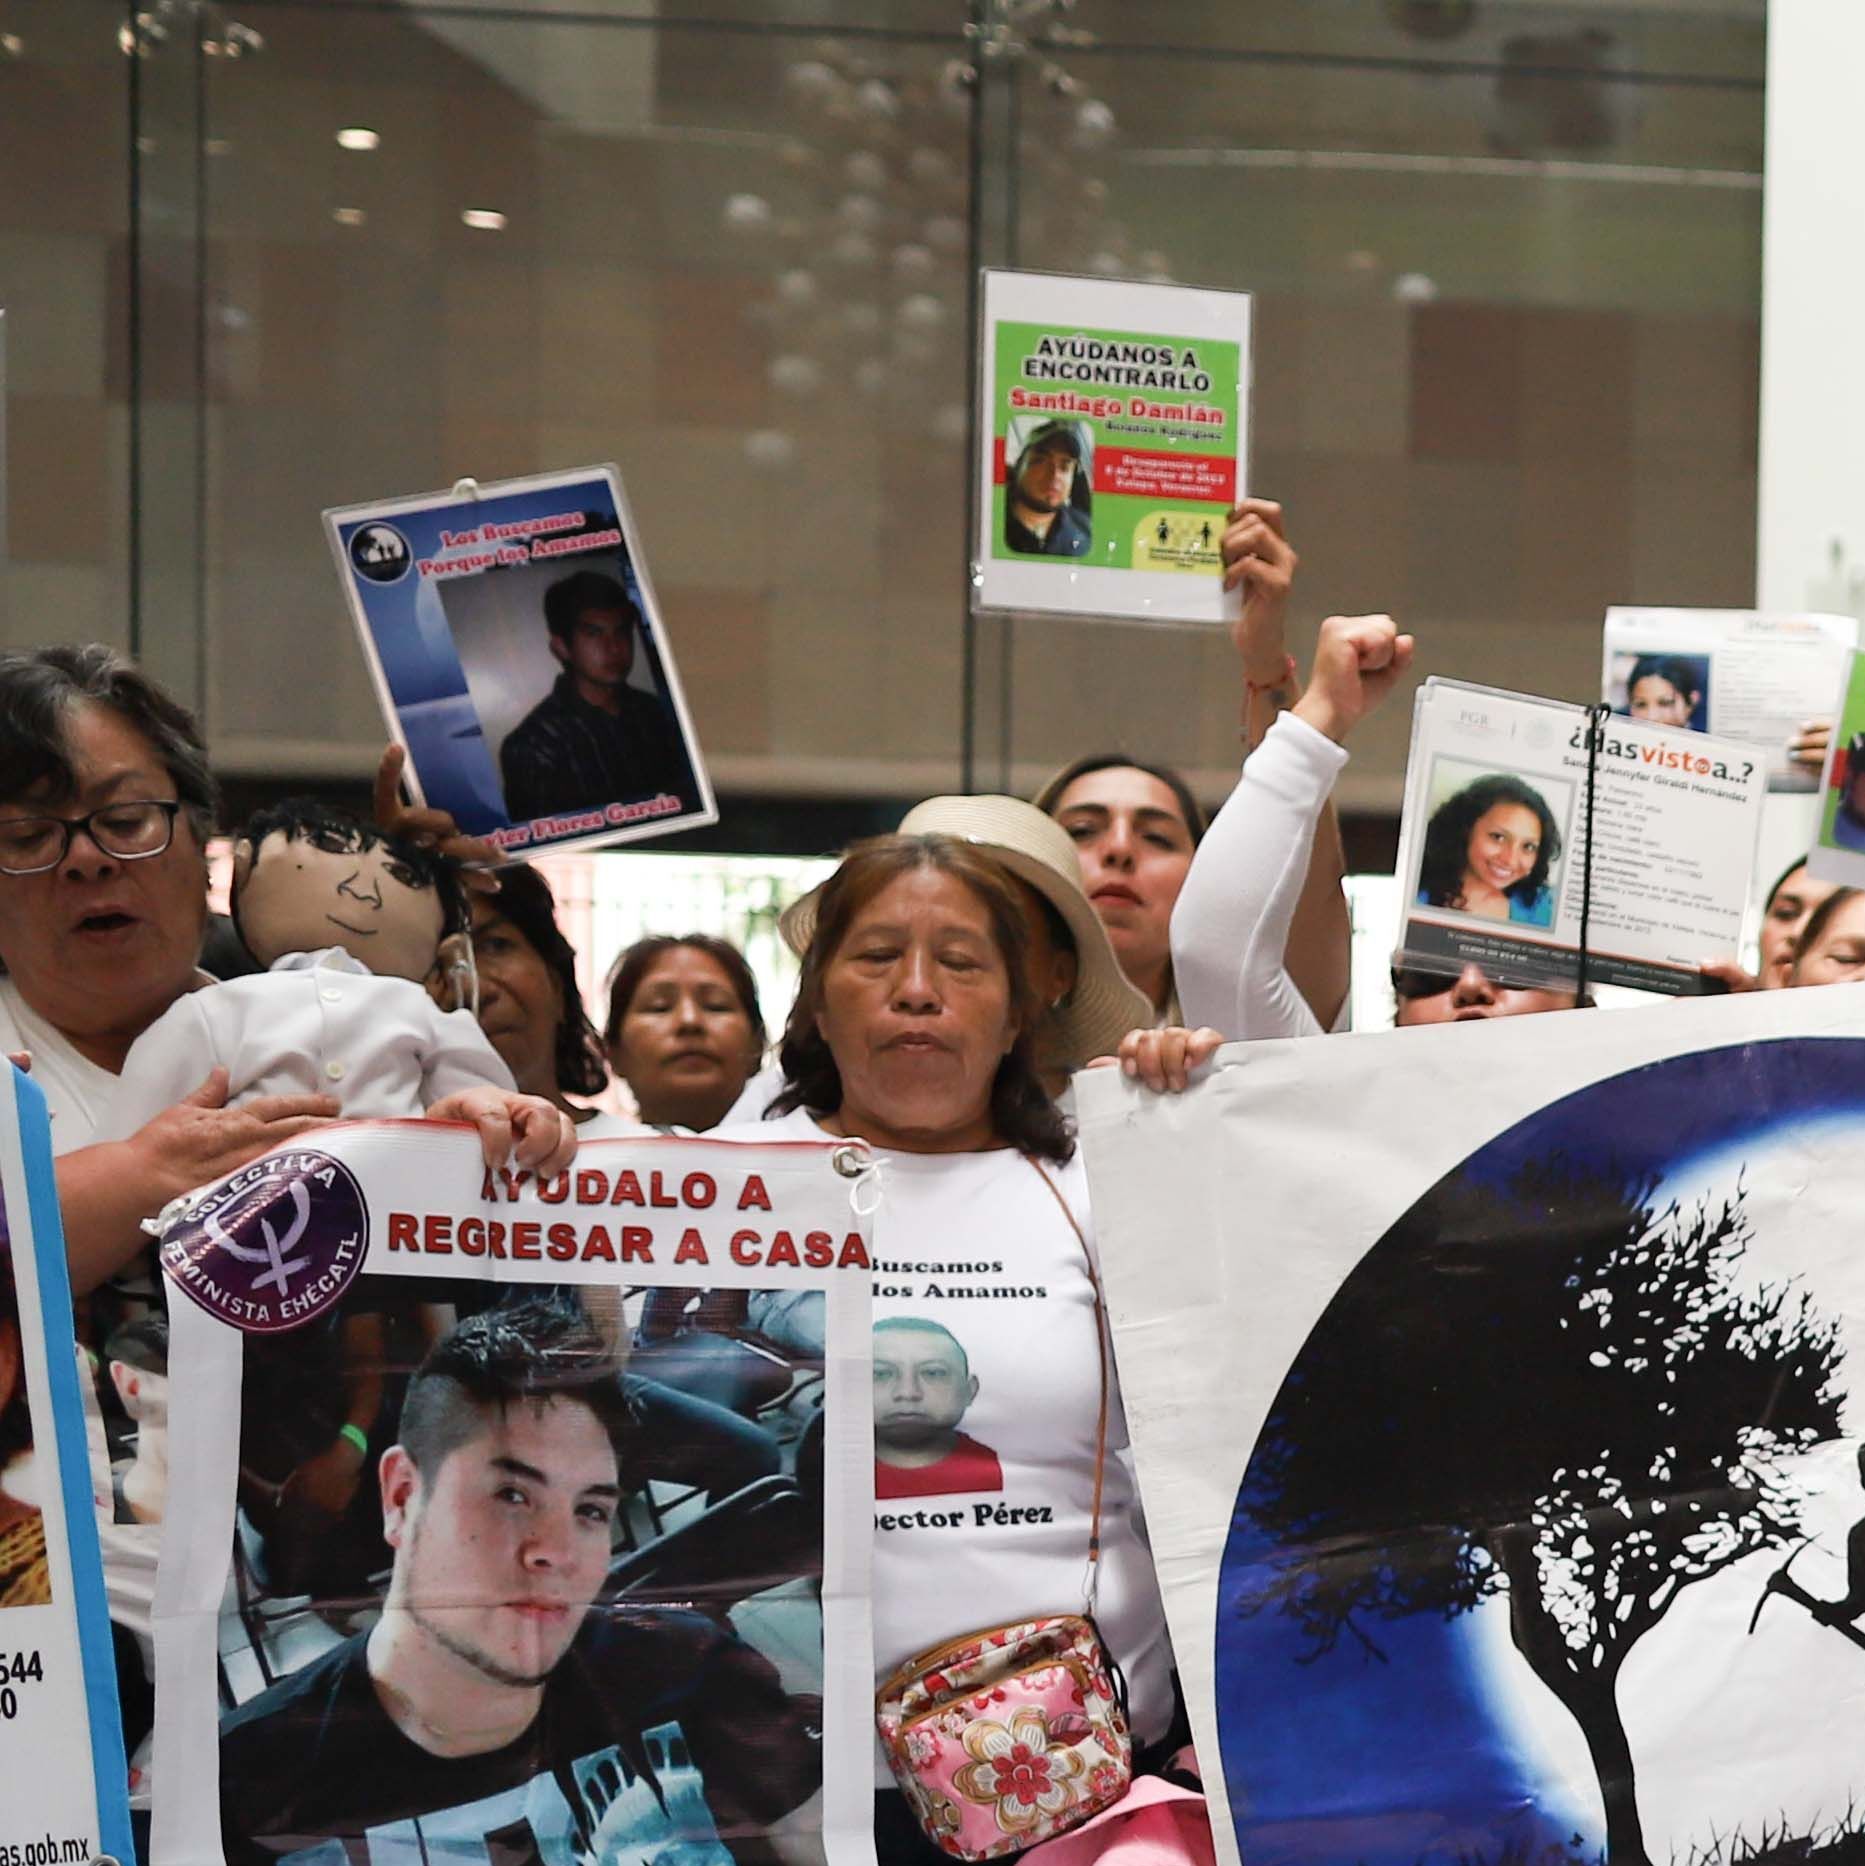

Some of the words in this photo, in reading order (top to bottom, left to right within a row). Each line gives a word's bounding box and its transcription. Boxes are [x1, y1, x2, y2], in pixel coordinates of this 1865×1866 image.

[1024, 359, 1210, 391] ENCONTRARLO
[1182, 350, 1197, 368] A
[1010, 388, 1121, 417] Santiago
[441, 527, 478, 550] Los
[484, 511, 585, 540] Buscamos
[418, 552, 494, 576] Porque
[497, 544, 529, 564] los
[531, 528, 622, 557] Amamos
[184, 1154, 337, 1223] COLECTIVA
[737, 1174, 772, 1211] A
[388, 1213, 653, 1261] REGRESAR
[674, 1227, 709, 1265] A
[729, 1229, 871, 1270] CASA
[164, 1240, 271, 1322] FEMINISTA
[924, 1284, 1048, 1299] Amamos
[874, 1510, 964, 1531] ector
[972, 1501, 1054, 1527] Pérez
